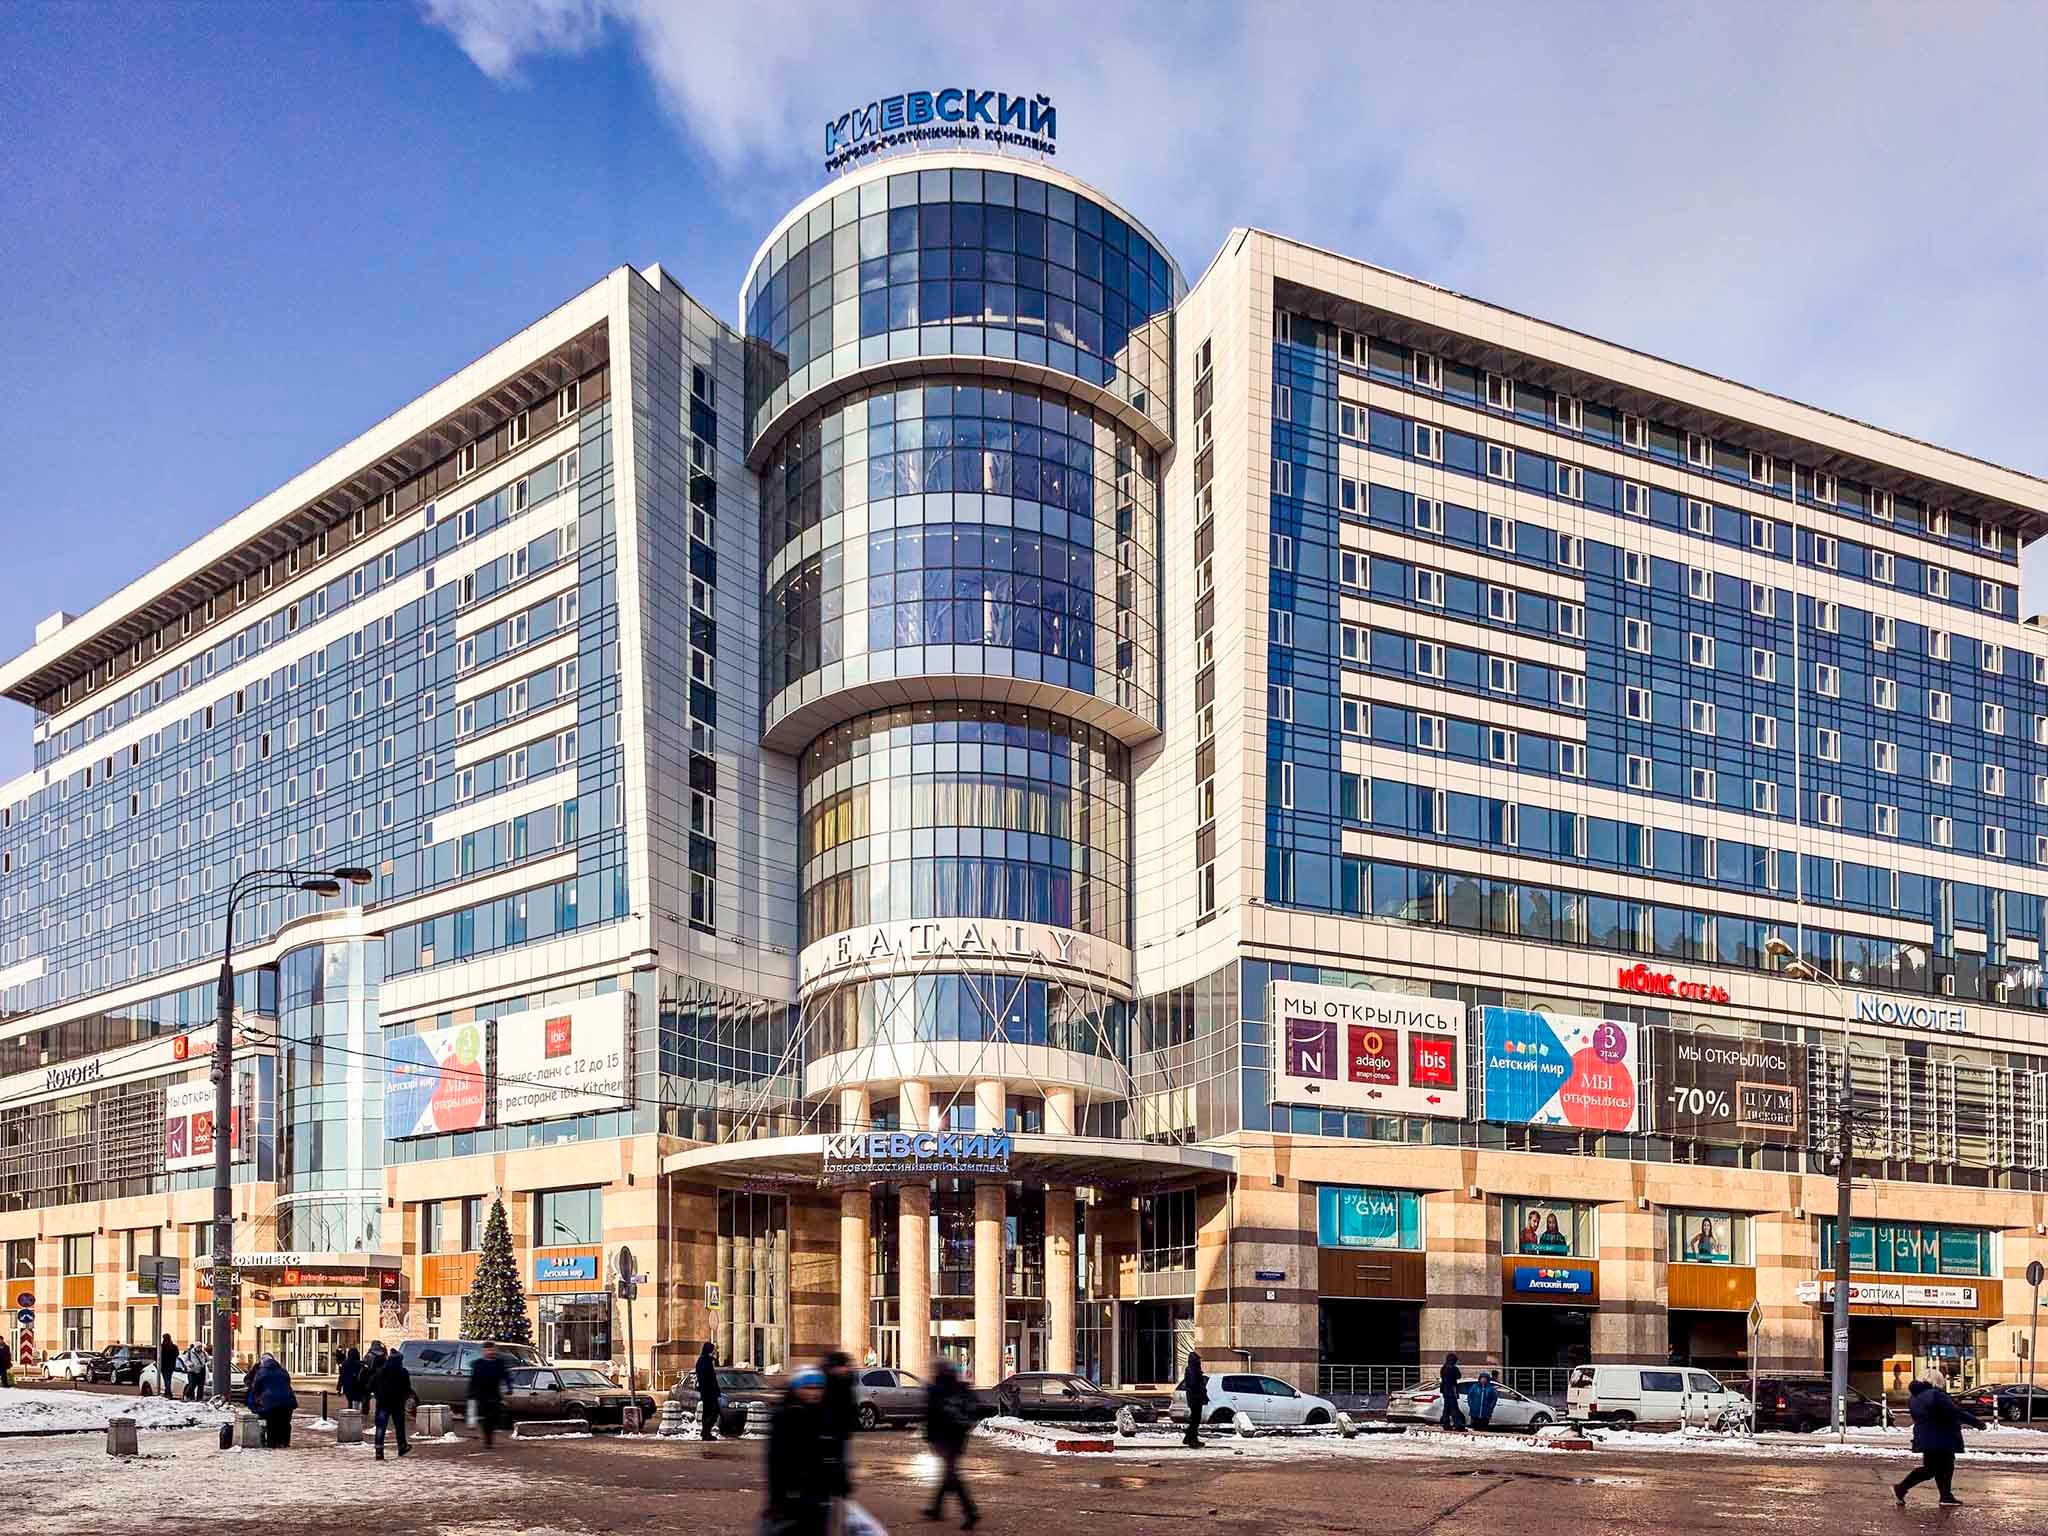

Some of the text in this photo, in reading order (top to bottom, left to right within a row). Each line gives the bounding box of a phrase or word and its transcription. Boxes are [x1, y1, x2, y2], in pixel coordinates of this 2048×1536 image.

[825, 88, 1057, 155] КИЕВСКИЙ
[834, 923, 1078, 967] EATALY
[1284, 998, 1317, 1015] МЫ
[1325, 1002, 1448, 1030] ОТКРЫЛИСЬ
[1856, 993, 1969, 1035] NOVOTEL
[551, 1030, 567, 1043] ibis
[1603, 1026, 1616, 1049] 3
[574, 1059, 585, 1074] 12
[589, 1059, 603, 1073] до
[607, 1052, 619, 1068] 15
[1302, 1050, 1321, 1073] N
[1356, 1053, 1391, 1071] adagio
[1419, 1050, 1447, 1069] ibis
[1489, 1056, 1564, 1078] Детский мир
[1678, 1045, 1787, 1070] МЫ ОТКРЫЛИСЬ
[46, 1058, 104, 1090] NOVOTEL
[506, 1089, 558, 1112] ресторане
[560, 1084, 579, 1099] ibis
[1562, 1092, 1632, 1110] открылись!
[1667, 1086, 1730, 1118] -70%
[823, 1128, 1011, 1160] КИЕВСКИЙ
[1355, 1201, 1394, 1217] GYM
[1896, 1238, 1937, 1259] GYM
[1529, 1280, 1562, 1289] Детский
[1860, 1287, 1901, 1300] ОПТИКА
